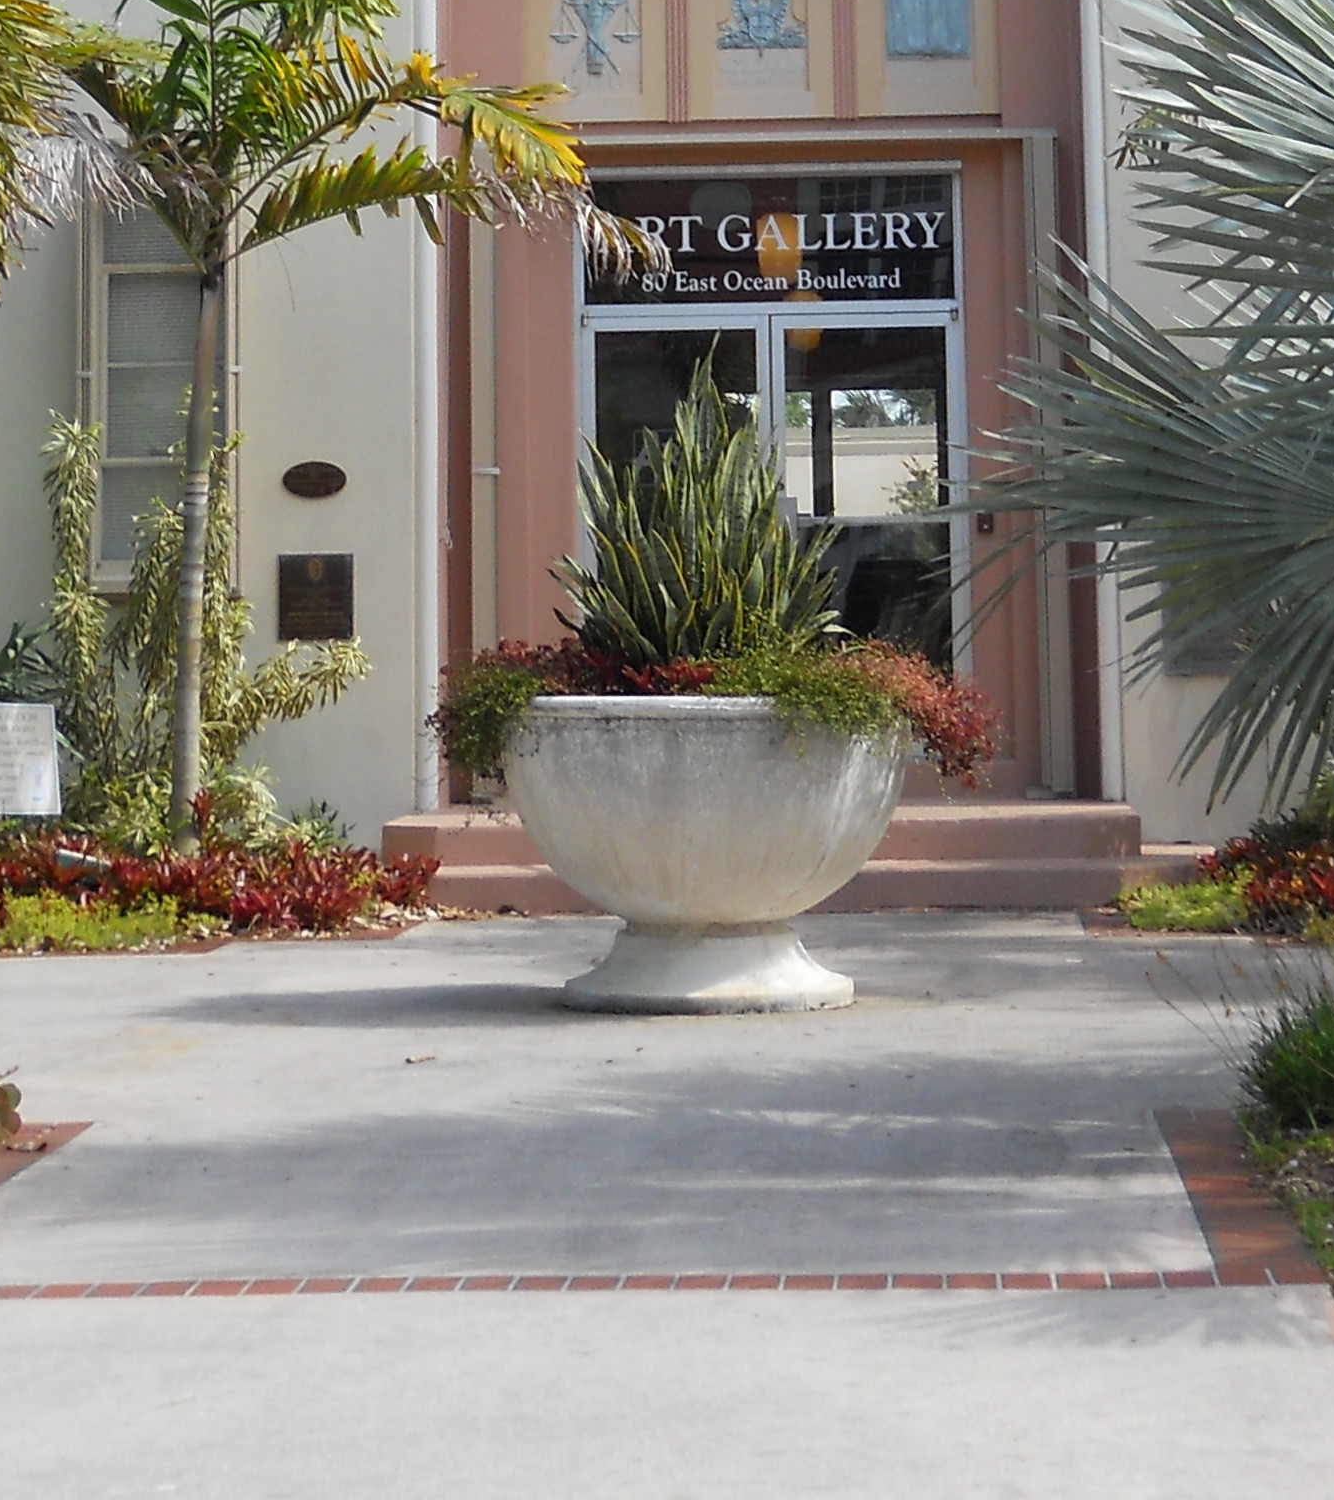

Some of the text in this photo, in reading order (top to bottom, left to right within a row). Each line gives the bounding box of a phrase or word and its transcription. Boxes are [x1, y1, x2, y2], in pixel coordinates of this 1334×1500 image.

[599, 212, 946, 254] RT GALLERY
[641, 268, 901, 293] 80 East Ocean Boulevard
